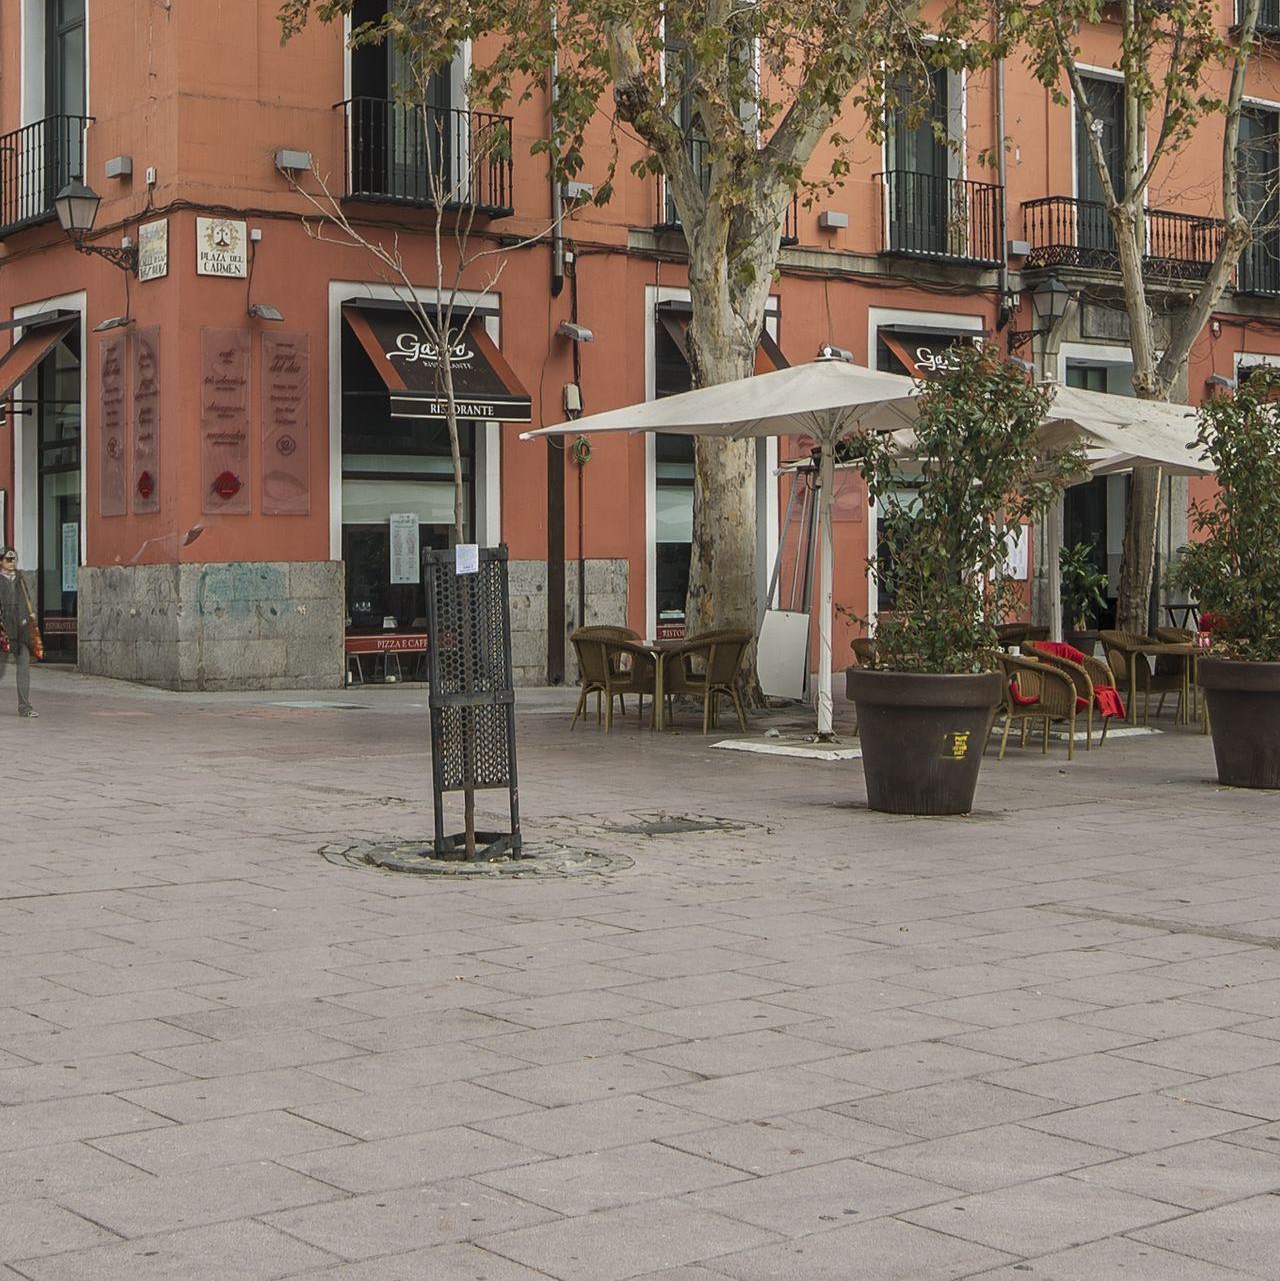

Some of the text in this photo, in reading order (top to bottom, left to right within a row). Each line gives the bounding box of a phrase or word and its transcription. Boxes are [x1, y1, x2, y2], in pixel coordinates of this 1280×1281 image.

[200, 251, 244, 263] PLAZA DEL
[203, 261, 241, 274] CARMEN
[385, 327, 475, 361] Gao
[430, 403, 495, 416] RISORANTE
[377, 639, 401, 649] PIZZA
